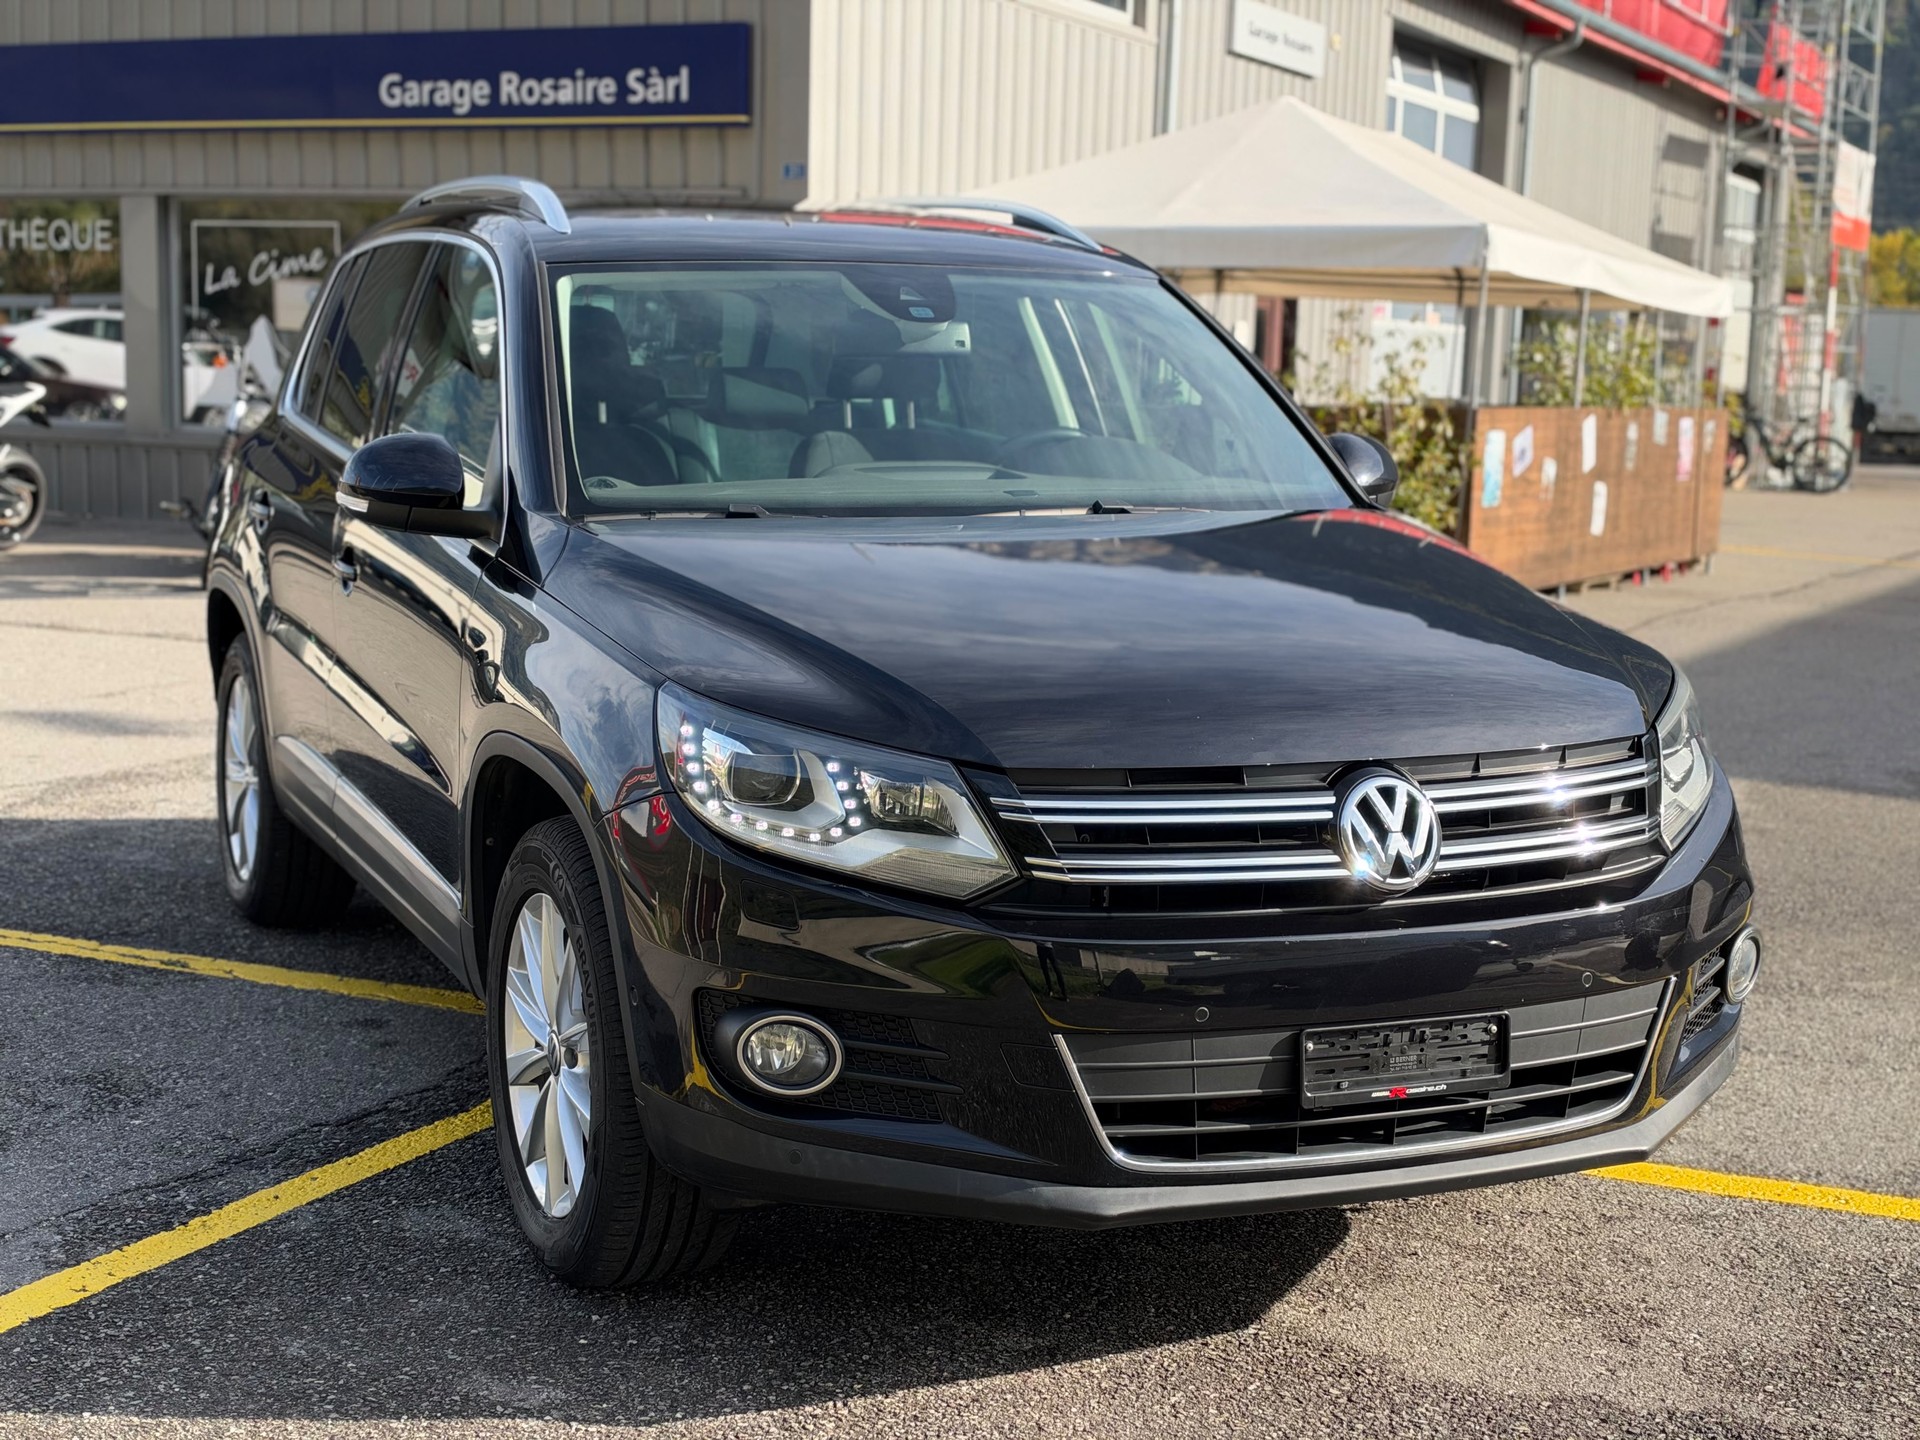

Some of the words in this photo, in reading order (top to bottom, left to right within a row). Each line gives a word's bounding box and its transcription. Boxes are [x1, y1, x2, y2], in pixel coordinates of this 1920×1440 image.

[379, 72, 492, 115] Garage
[499, 68, 618, 106] Rosaire
[626, 65, 690, 103] Sàrl
[204, 262, 242, 295] La
[248, 246, 328, 287] Cime
